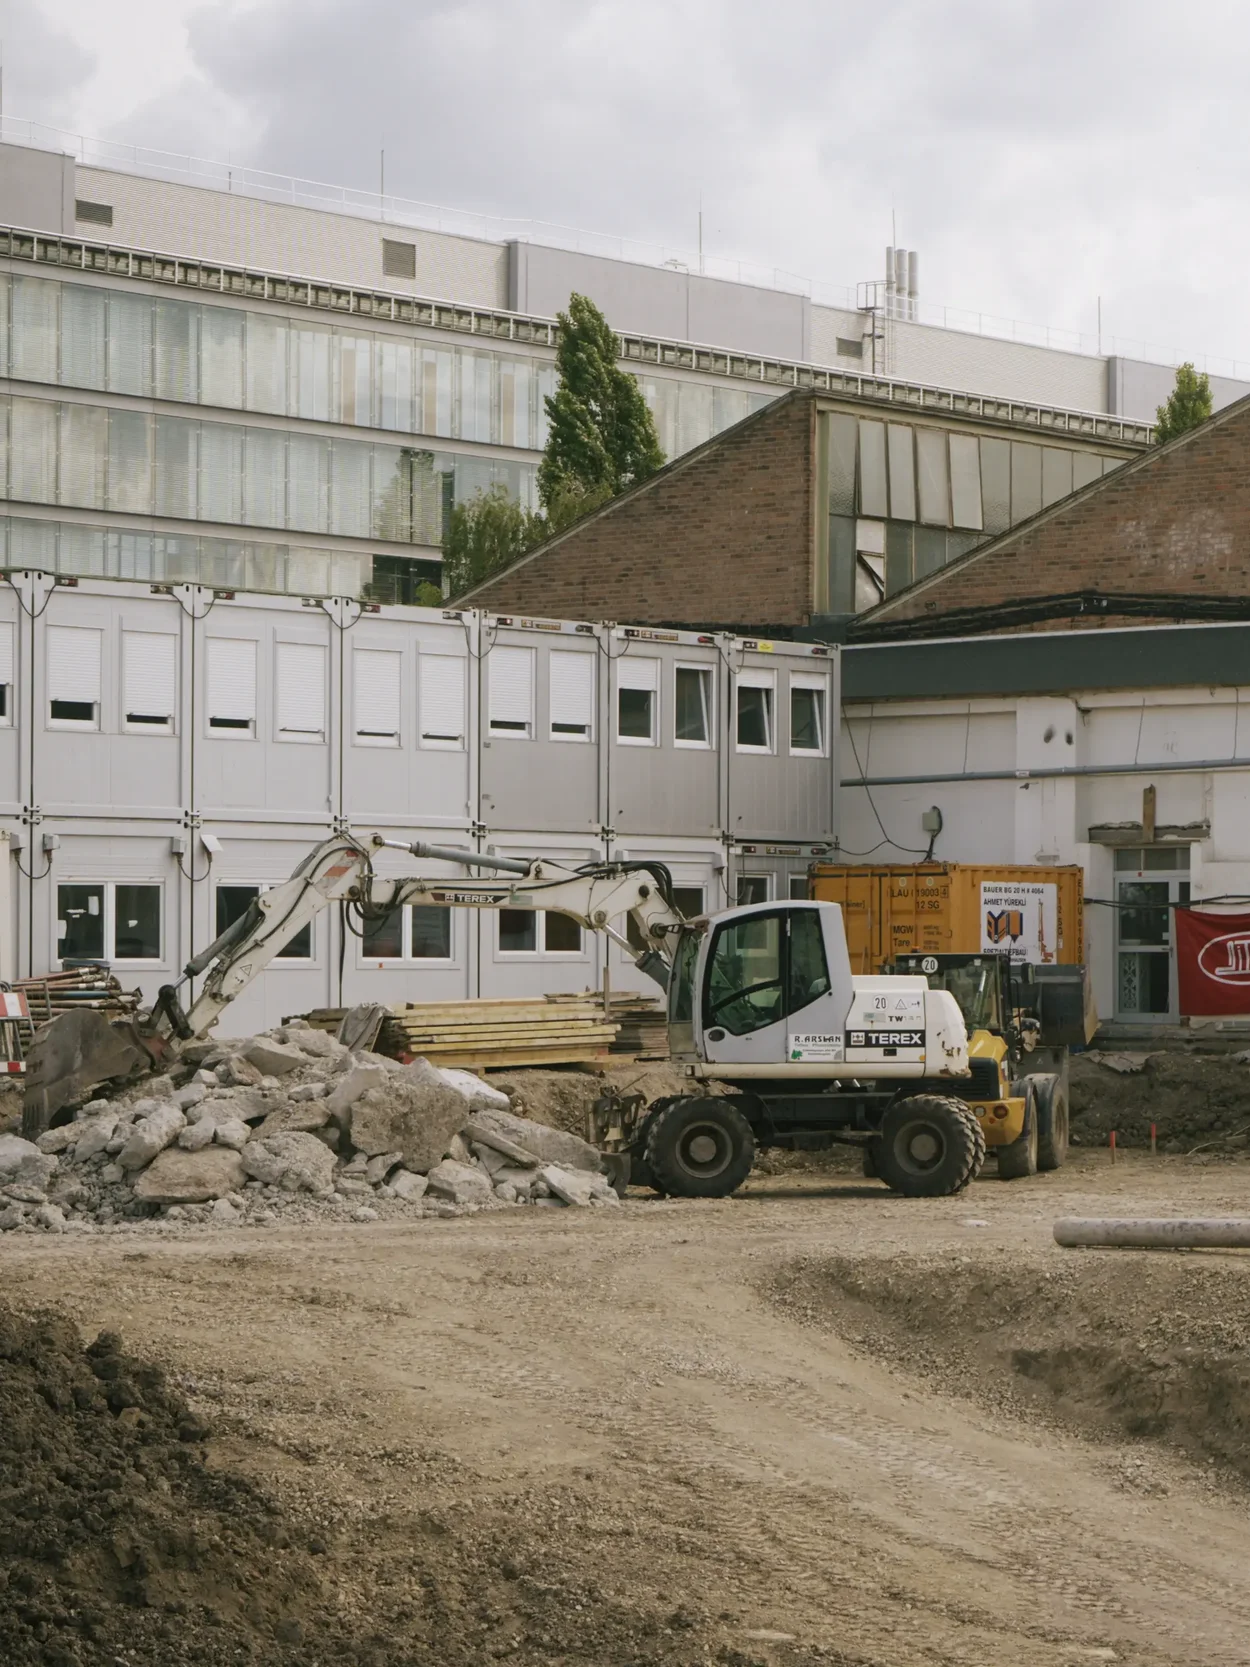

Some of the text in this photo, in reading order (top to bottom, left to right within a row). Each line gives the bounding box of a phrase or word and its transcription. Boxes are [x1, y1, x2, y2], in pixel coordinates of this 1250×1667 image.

[983, 886, 1003, 894] BAUER
[1004, 886, 1012, 894] BG
[457, 894, 494, 903] TEREX
[983, 898, 1003, 906] AHMET
[927, 900, 940, 909] SG
[893, 925, 914, 934] MGW
[893, 938, 911, 947] Tare
[925, 960, 935, 971] 20
[875, 997, 887, 1009] 20
[794, 1035, 841, 1043] R.ARSLAN
[868, 1033, 922, 1044] TEREX
